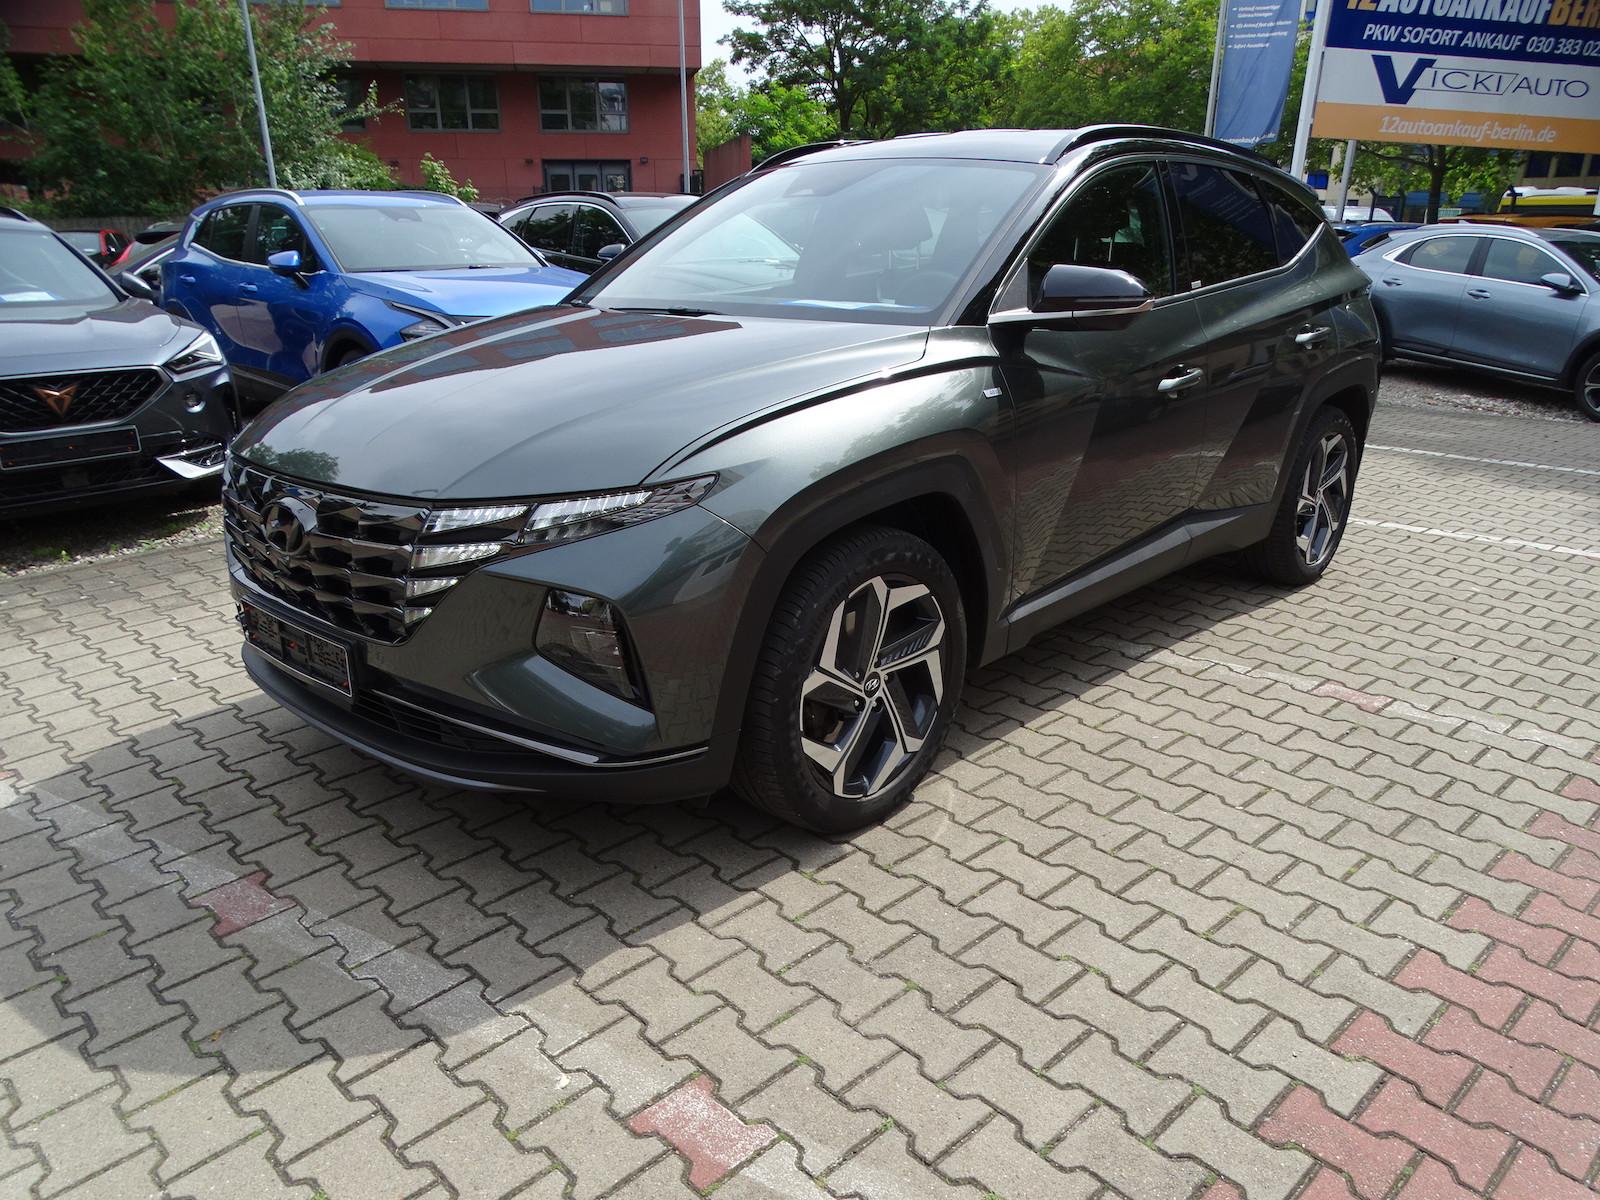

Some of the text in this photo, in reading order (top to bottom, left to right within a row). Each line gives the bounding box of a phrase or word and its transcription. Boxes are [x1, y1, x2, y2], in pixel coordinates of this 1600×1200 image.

[1362, 24, 1402, 43] PKW
[1401, 26, 1463, 47] SOFORT
[1459, 31, 1524, 51] ANKAUF
[1526, 36, 1555, 53] 030
[1554, 38, 1583, 56] 383
[1512, 76, 1589, 98] AUTO
[1378, 115, 1557, 144] 12autoankauf-berlin.de
